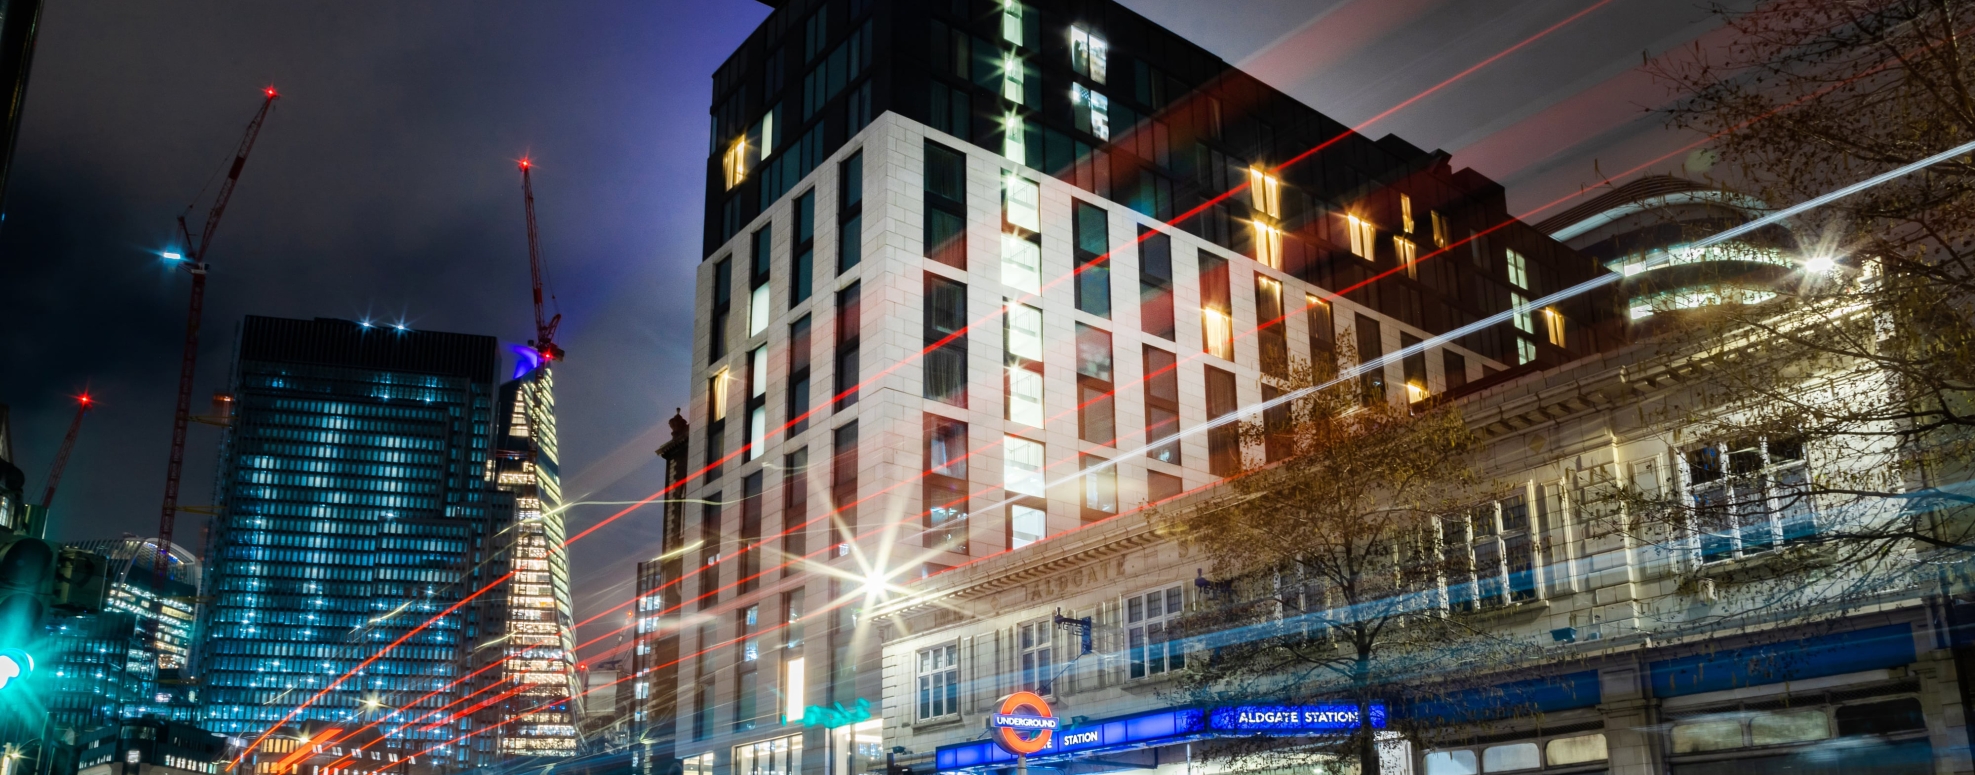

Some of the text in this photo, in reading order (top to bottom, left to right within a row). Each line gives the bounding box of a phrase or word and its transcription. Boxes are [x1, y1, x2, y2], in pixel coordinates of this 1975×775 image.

[1031, 555, 1126, 601] ALDGATE
[996, 716, 1056, 728] UNDERGROUND
[1239, 711, 1359, 723] ALDGATE STATION
[1064, 731, 1098, 746] STATION
